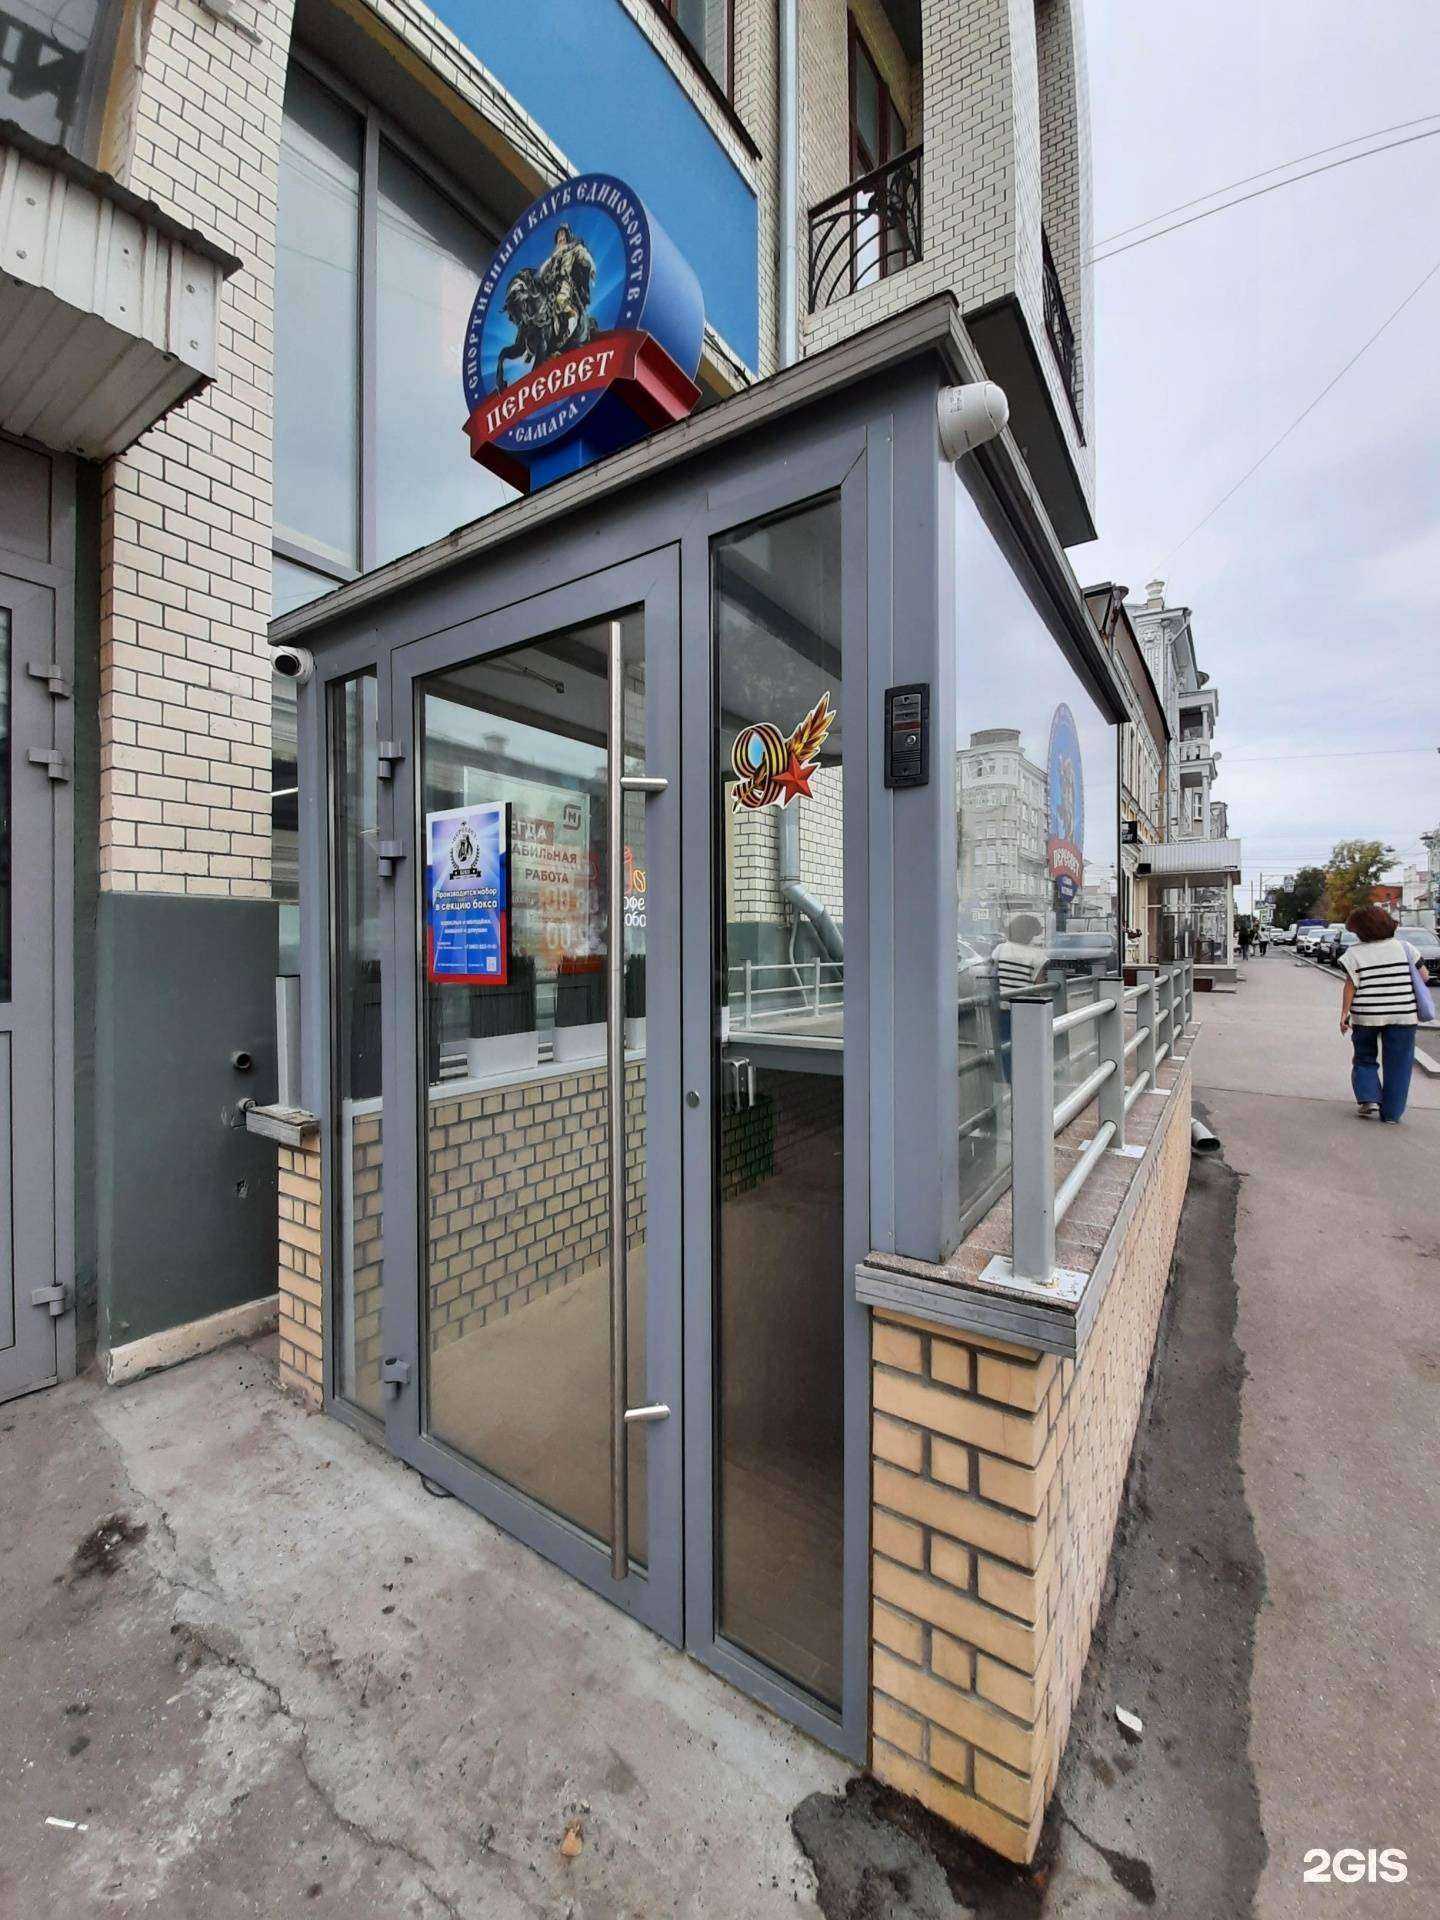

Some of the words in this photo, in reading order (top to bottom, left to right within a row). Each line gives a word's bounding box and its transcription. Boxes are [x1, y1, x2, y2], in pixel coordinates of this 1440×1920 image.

[527, 186, 572, 230] КЛУБ
[485, 350, 614, 434] ПЕРЕСВЕТ
[514, 404, 578, 442] САМАРА
[511, 820, 548, 841] ЕГДА
[511, 843, 578, 864] АБИЛЬНАЯ
[525, 868, 570, 884] РАБОТА
[441, 901, 471, 911] секцию
[472, 899, 498, 909] бокса
[623, 896, 646, 911] офе
